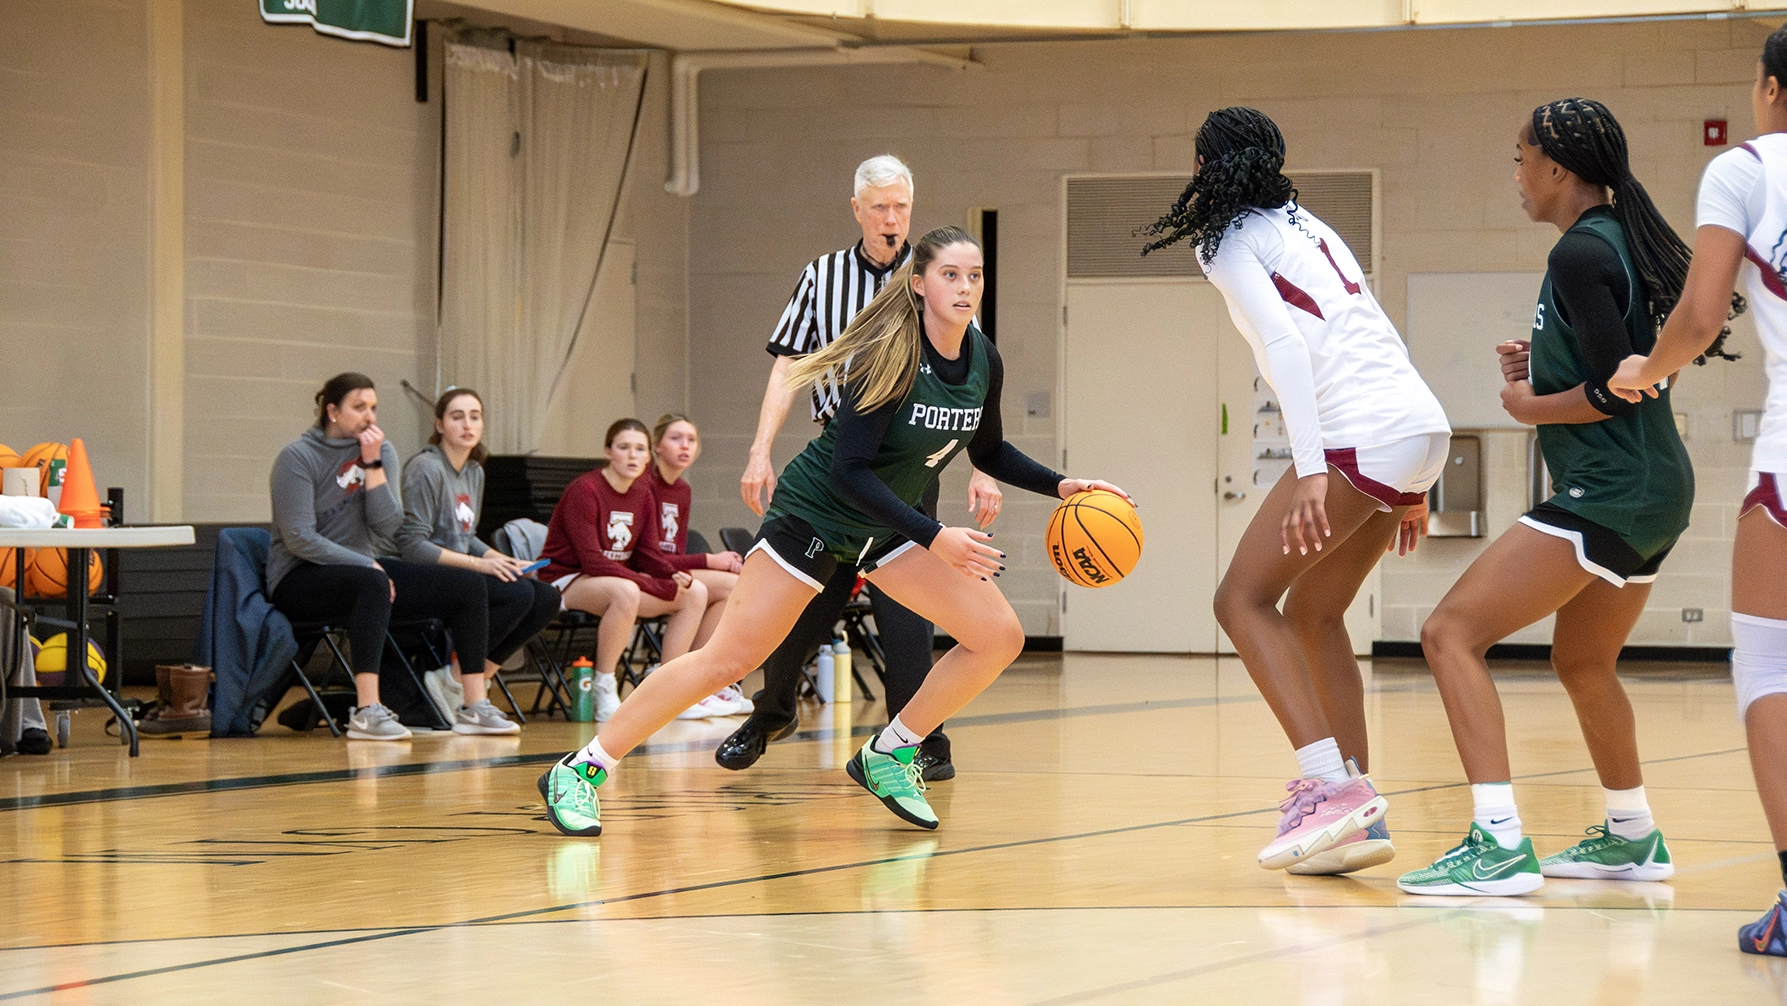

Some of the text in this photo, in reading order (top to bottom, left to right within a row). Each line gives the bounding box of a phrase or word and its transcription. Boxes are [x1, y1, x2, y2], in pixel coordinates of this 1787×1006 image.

[908, 403, 983, 431] PORTER
[924, 439, 959, 468] 4
[805, 537, 825, 559] P
[1072, 547, 1110, 584] NCAA
[579, 676, 592, 691] G
